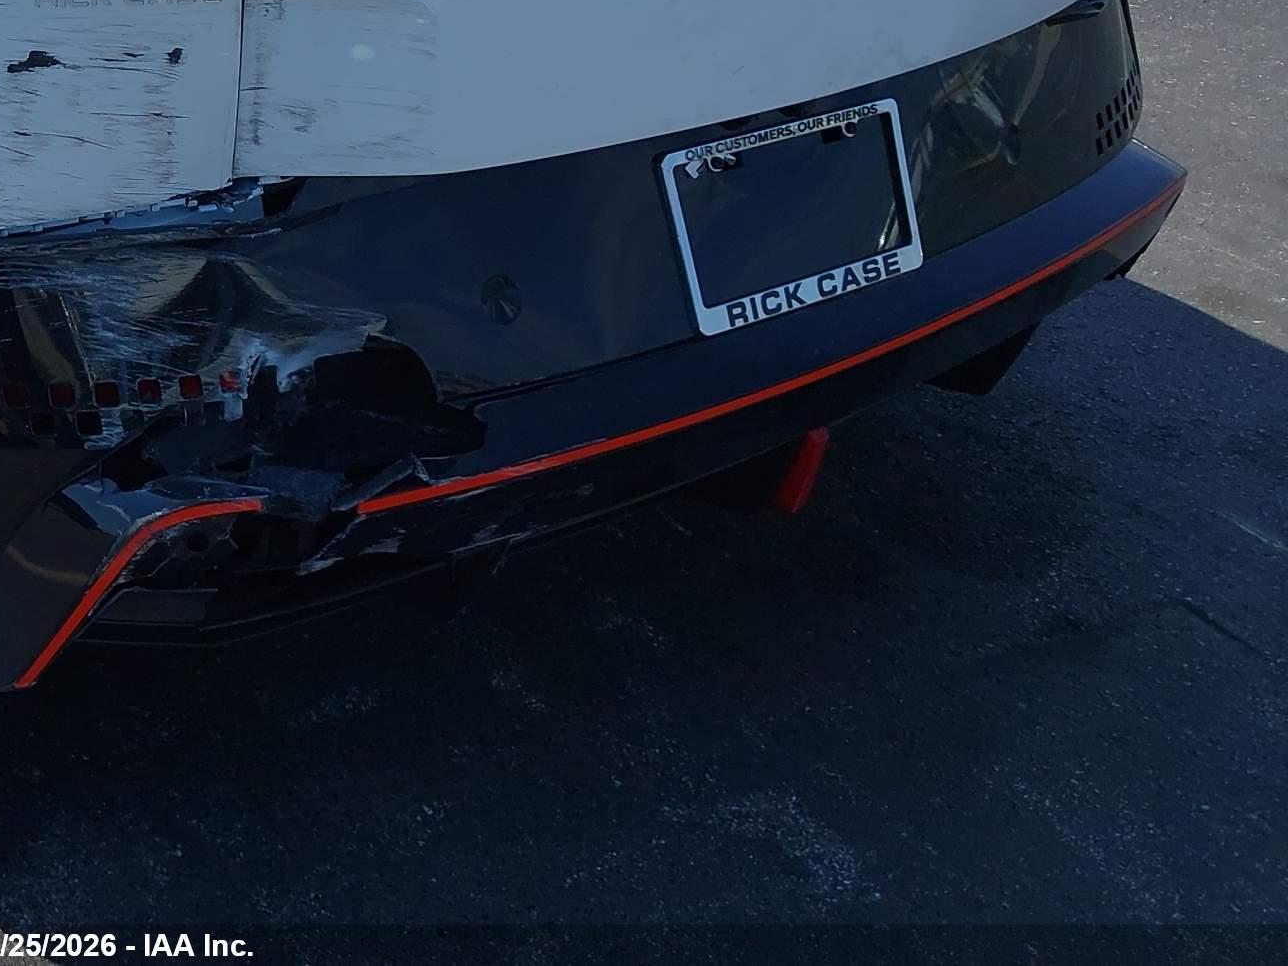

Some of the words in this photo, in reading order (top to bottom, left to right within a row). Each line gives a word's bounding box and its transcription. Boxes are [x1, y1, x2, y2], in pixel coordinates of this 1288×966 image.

[685, 144, 713, 162] OUR
[797, 117, 825, 133] OUR
[826, 104, 879, 125] FRIENDS
[726, 282, 807, 328] RICK
[816, 252, 901, 299] CASE
